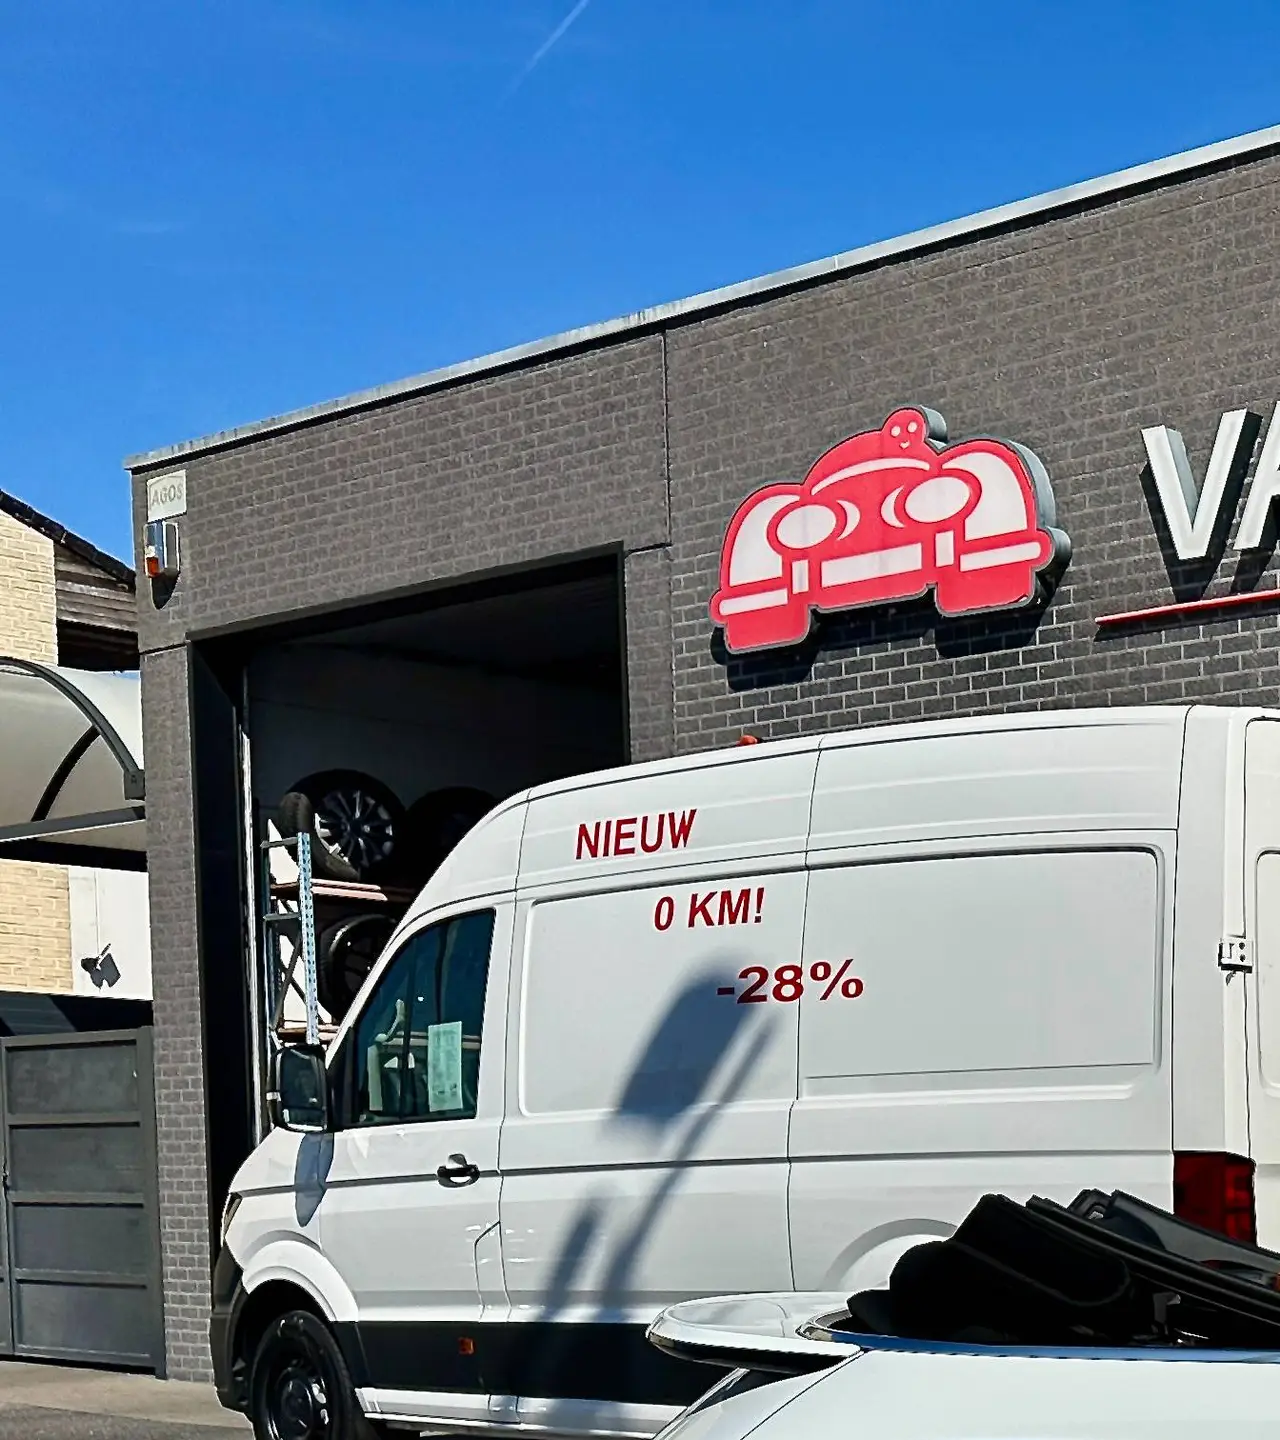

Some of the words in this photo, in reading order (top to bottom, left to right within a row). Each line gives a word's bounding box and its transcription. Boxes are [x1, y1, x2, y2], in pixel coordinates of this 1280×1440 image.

[575, 808, 698, 860] NIEUW
[653, 896, 675, 932] 0
[687, 886, 765, 929] KM!
[716, 957, 865, 1005] -28%
